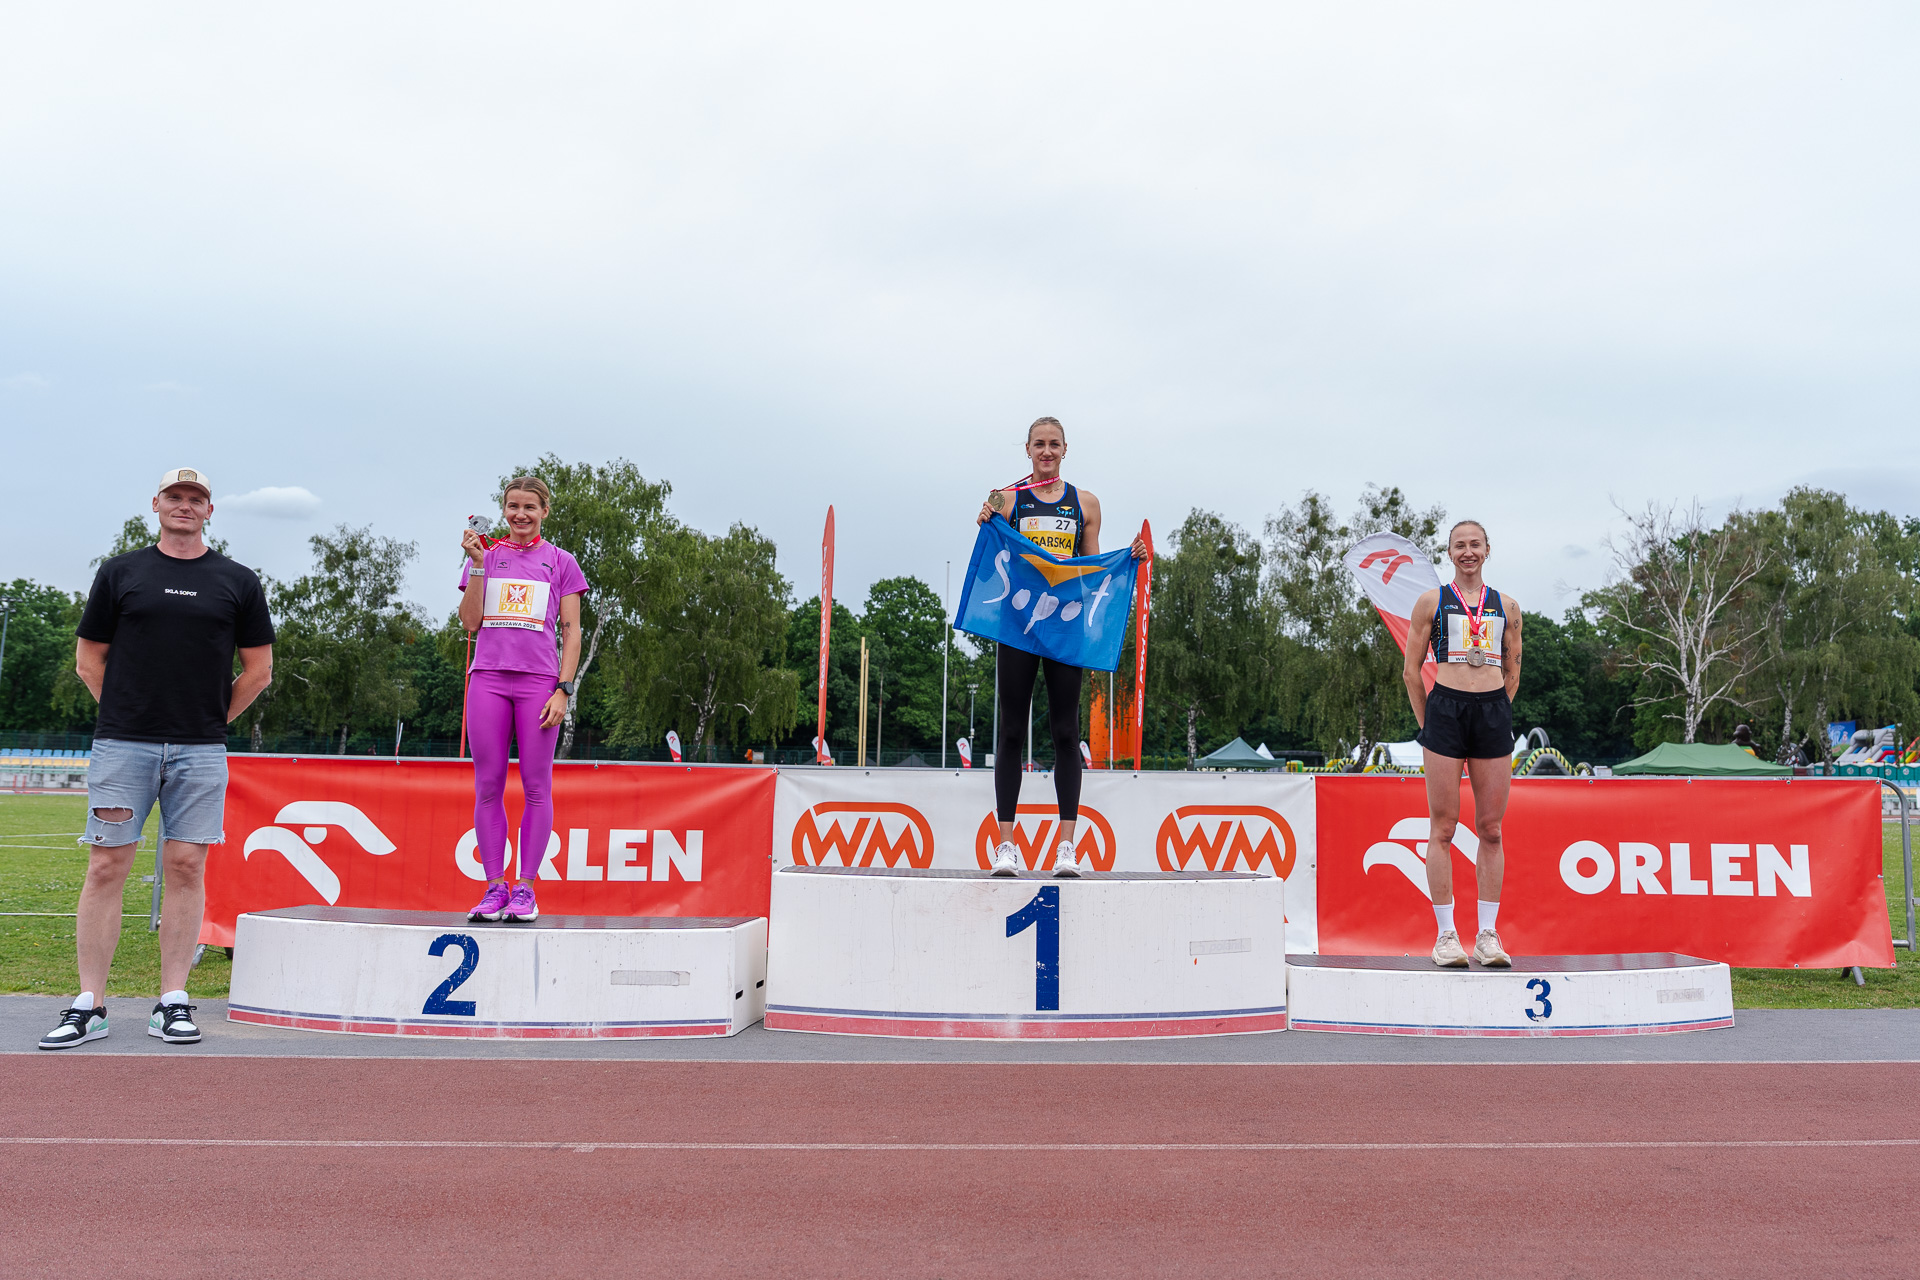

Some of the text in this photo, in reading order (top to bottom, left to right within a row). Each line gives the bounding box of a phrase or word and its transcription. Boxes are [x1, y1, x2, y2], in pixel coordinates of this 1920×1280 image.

[1055, 519, 1071, 531] 27
[500, 604, 528, 612] PZLA
[982, 549, 1112, 635] Sopot
[1559, 840, 1812, 897] ORLEN
[422, 933, 480, 1017] 2
[1005, 886, 1060, 1011] 1
[1524, 978, 1553, 1022] 3
